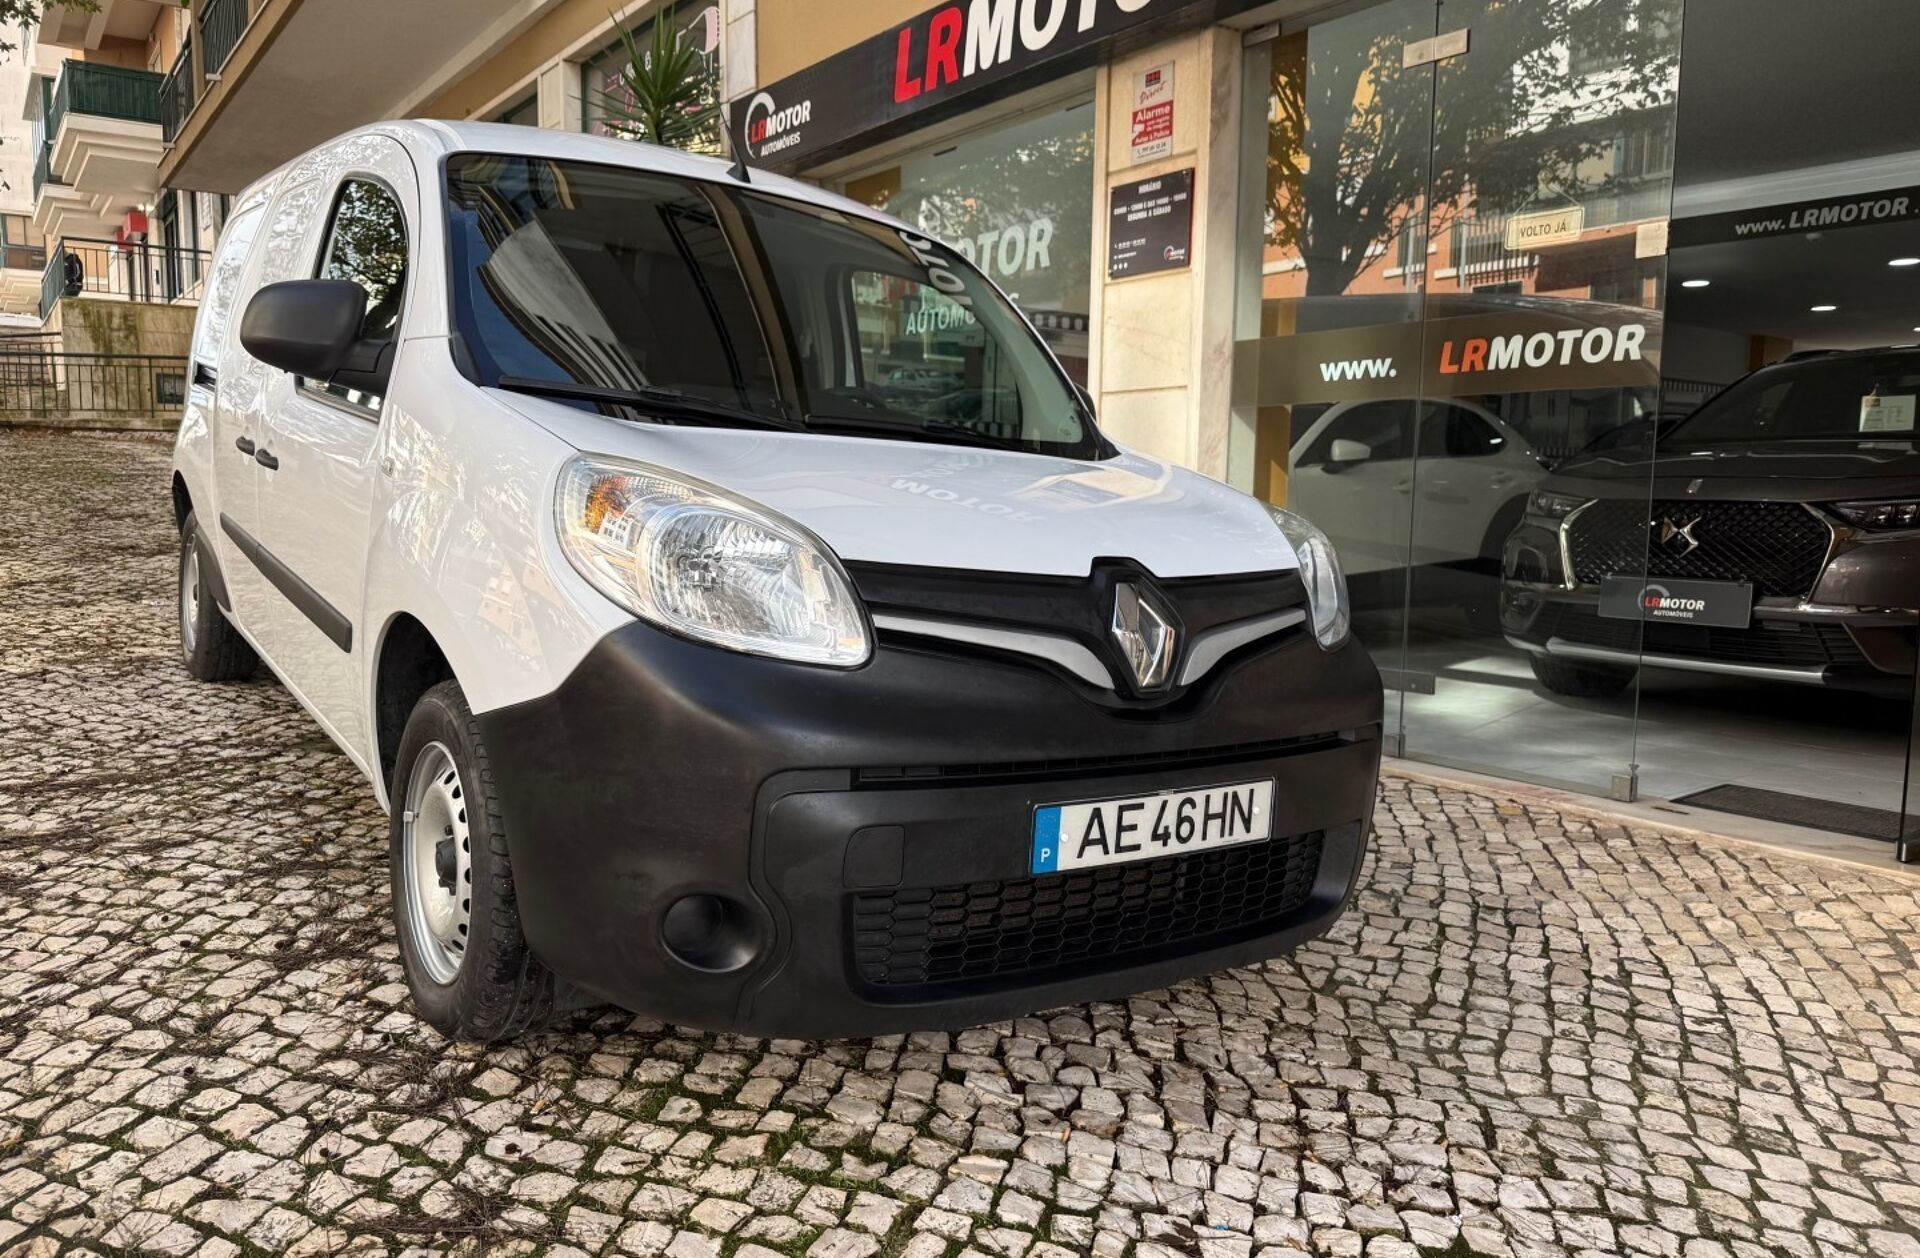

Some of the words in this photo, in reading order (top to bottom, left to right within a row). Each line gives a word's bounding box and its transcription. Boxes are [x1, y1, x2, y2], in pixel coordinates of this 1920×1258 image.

[751, 100, 811, 144] LRMOTOR
[1135, 105, 1170, 123] Alarme
[1520, 223, 1551, 238] VOLTO
[1554, 218, 1567, 234] JÁ
[1319, 357, 1397, 382] www.
[1439, 324, 1646, 375] LRMOTOR
[1644, 596, 1705, 611] LRMOTOR
[1040, 848, 1051, 863] P
